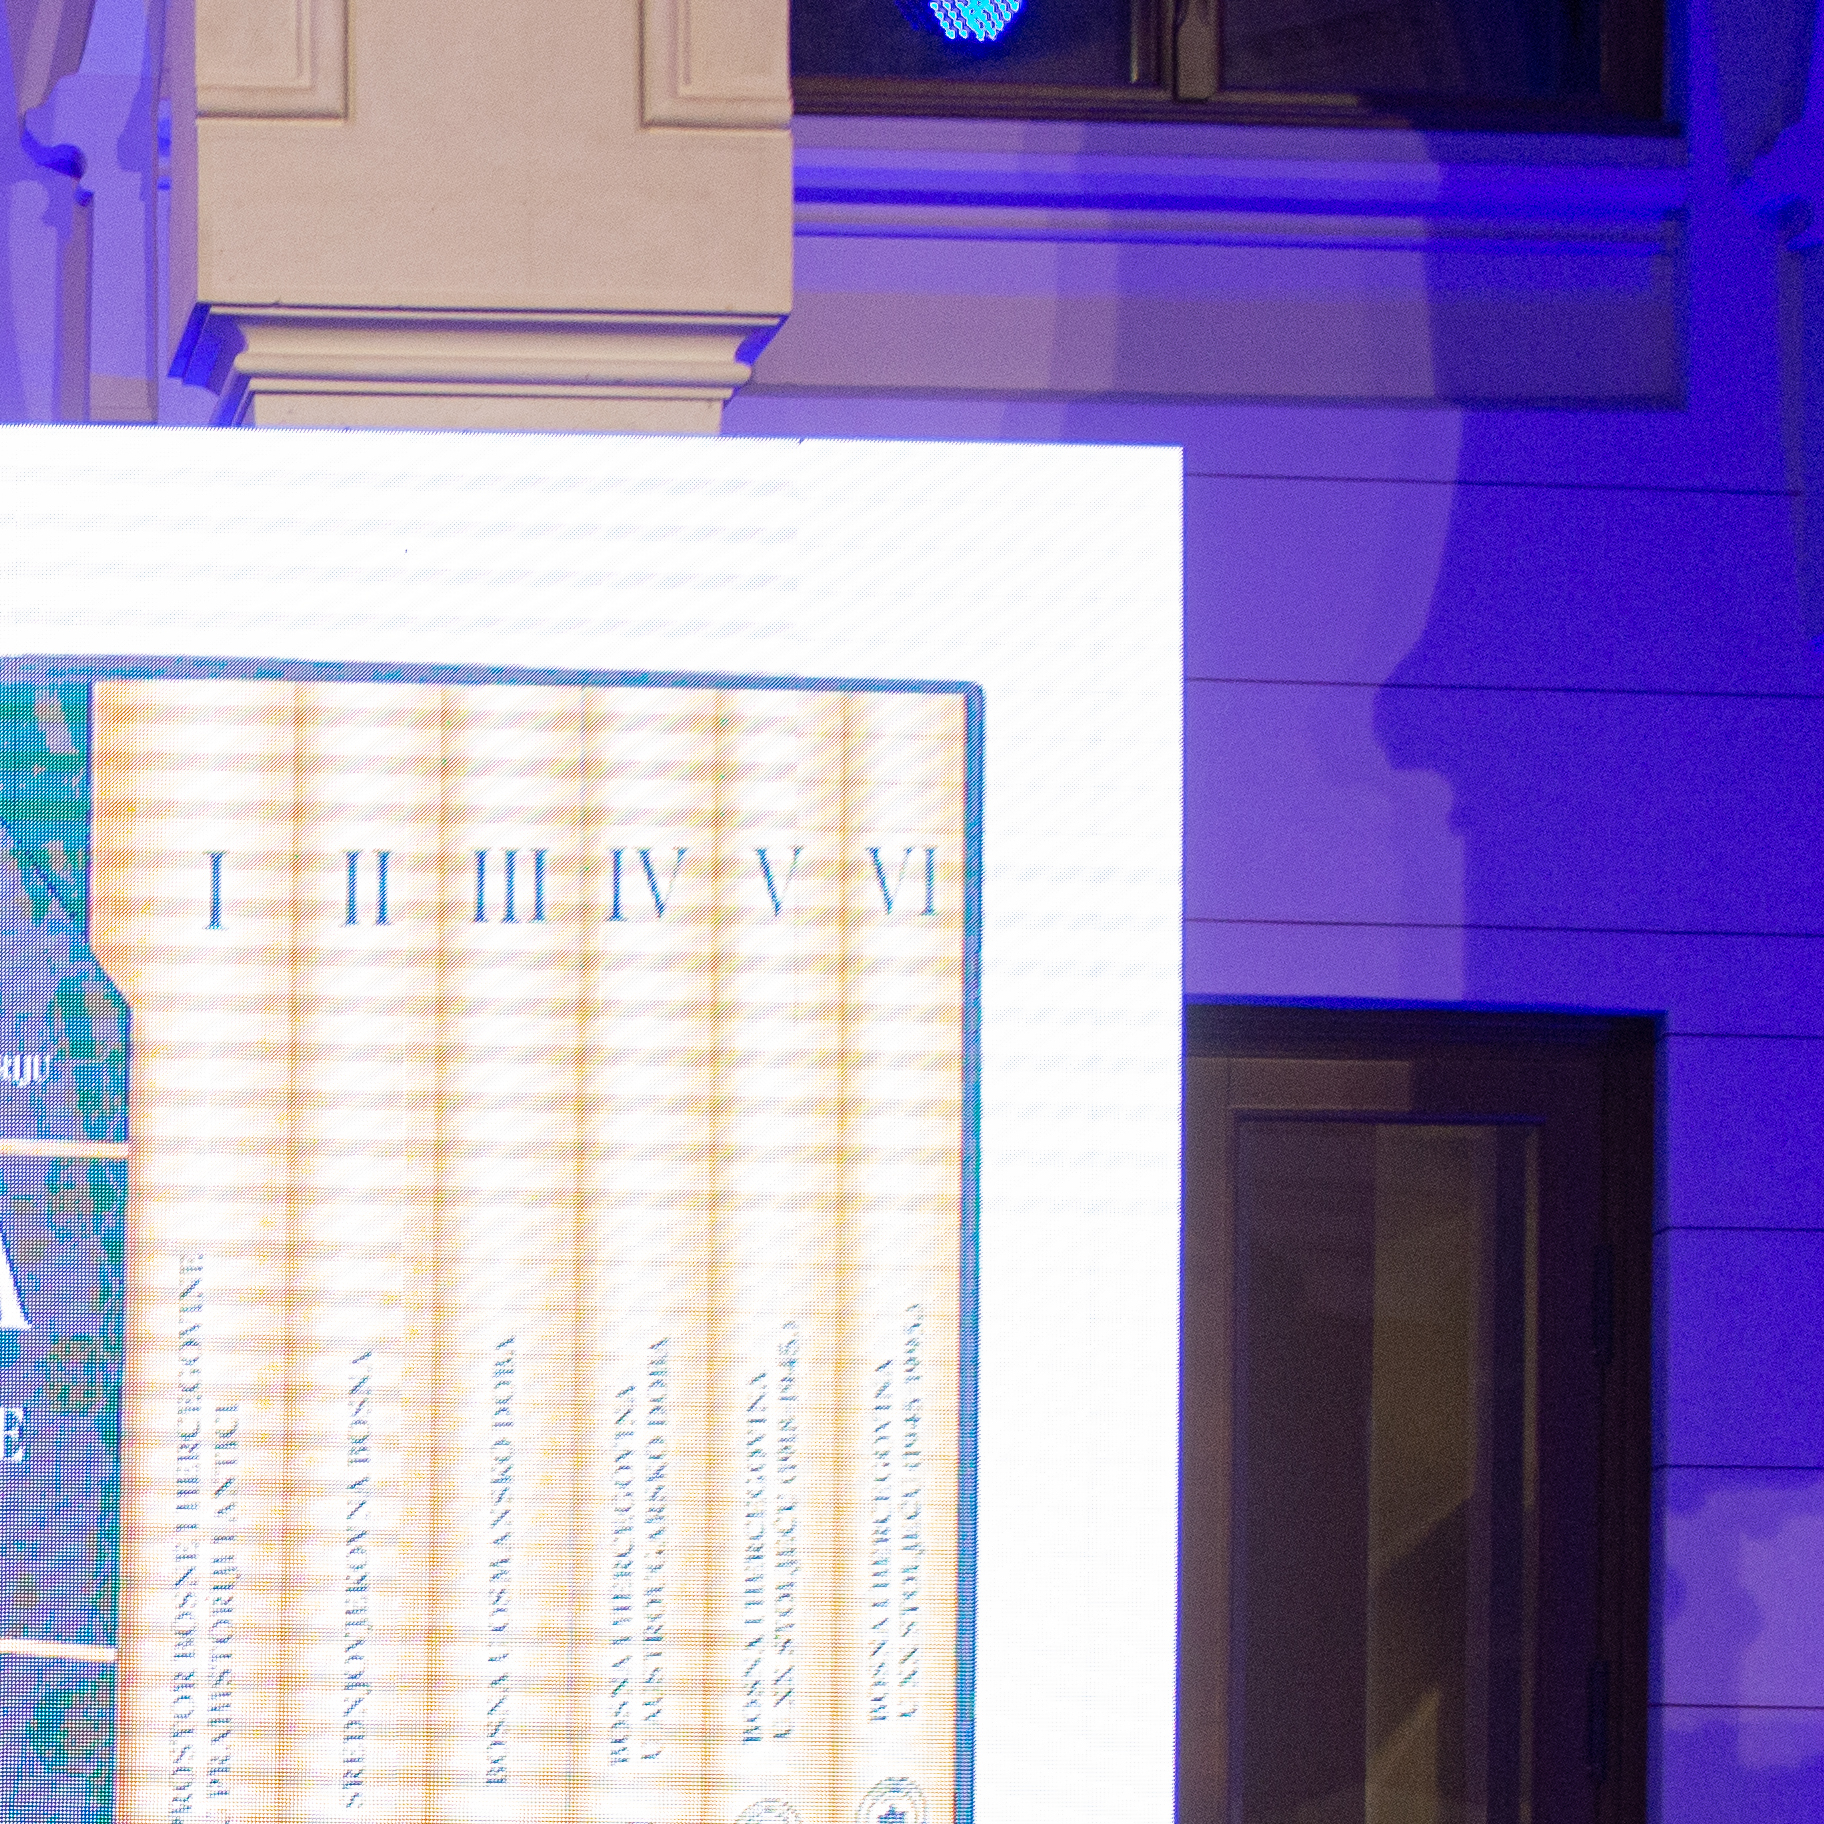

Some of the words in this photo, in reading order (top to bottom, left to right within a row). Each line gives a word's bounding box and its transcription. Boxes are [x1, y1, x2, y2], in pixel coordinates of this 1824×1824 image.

[202, 850, 230, 931] I
[342, 848, 396, 927] II
[472, 846, 550, 924] III
[605, 845, 689, 922] IV
[753, 845, 804, 919] V
[866, 845, 940, 918] VI
[176, 1253, 204, 1512] HERCEGOVINE
[347, 1349, 373, 1465] BOSNA
[173, 1543, 200, 1659] BOSNE
[486, 1673, 510, 1786] BOSNA
